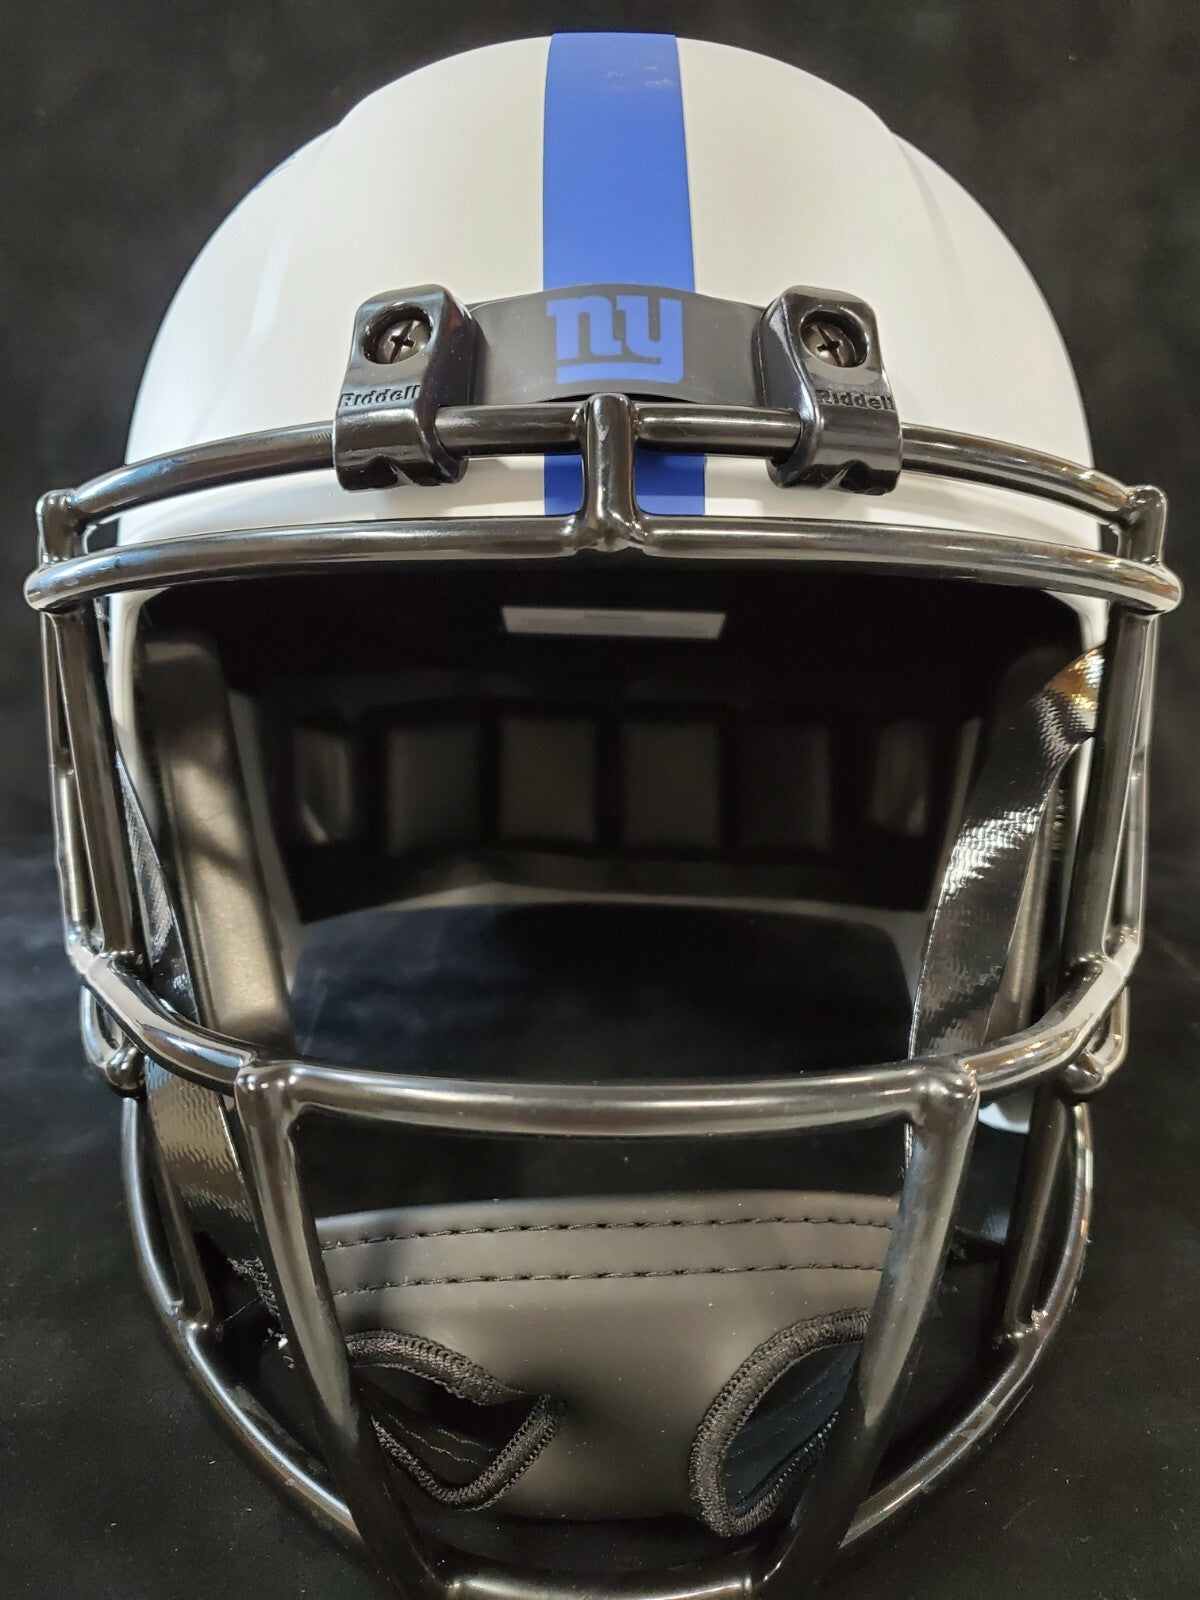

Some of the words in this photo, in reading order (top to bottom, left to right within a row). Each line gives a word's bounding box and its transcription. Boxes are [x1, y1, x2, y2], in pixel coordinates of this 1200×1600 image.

[546, 295, 684, 384] ny
[338, 384, 420, 408] Riddell
[815, 388, 894, 411] Riddell
